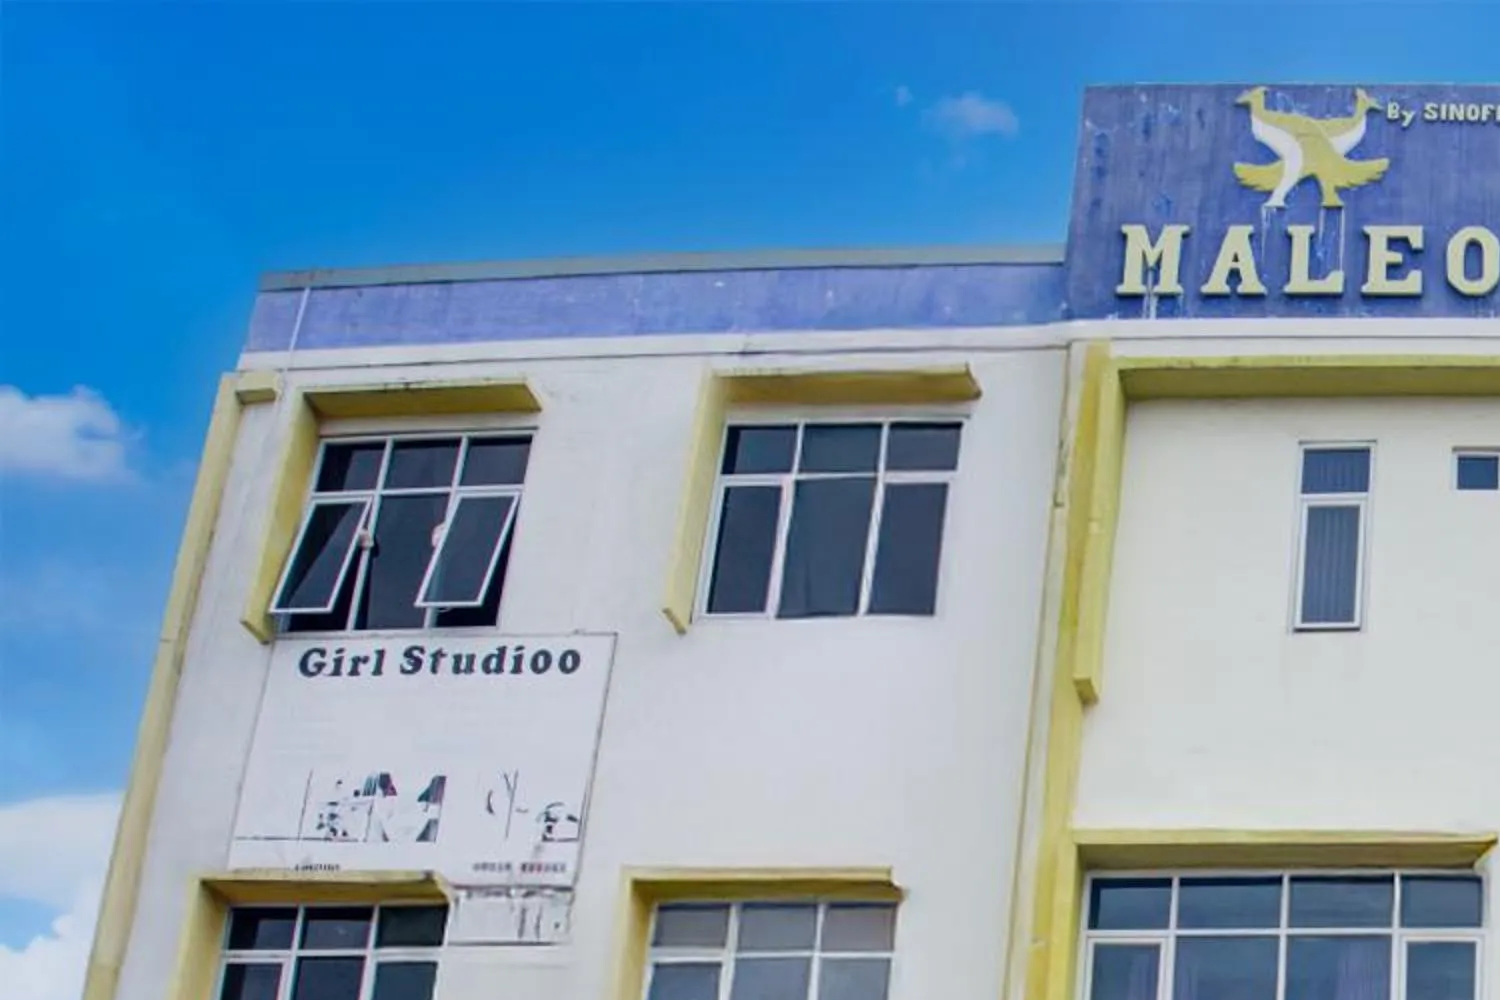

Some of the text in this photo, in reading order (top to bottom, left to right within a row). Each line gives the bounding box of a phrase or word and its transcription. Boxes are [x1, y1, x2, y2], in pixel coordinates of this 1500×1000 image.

[1386, 102, 1415, 126] By
[1114, 223, 1500, 297] MALEO
[298, 645, 582, 677] Girl Studioo
